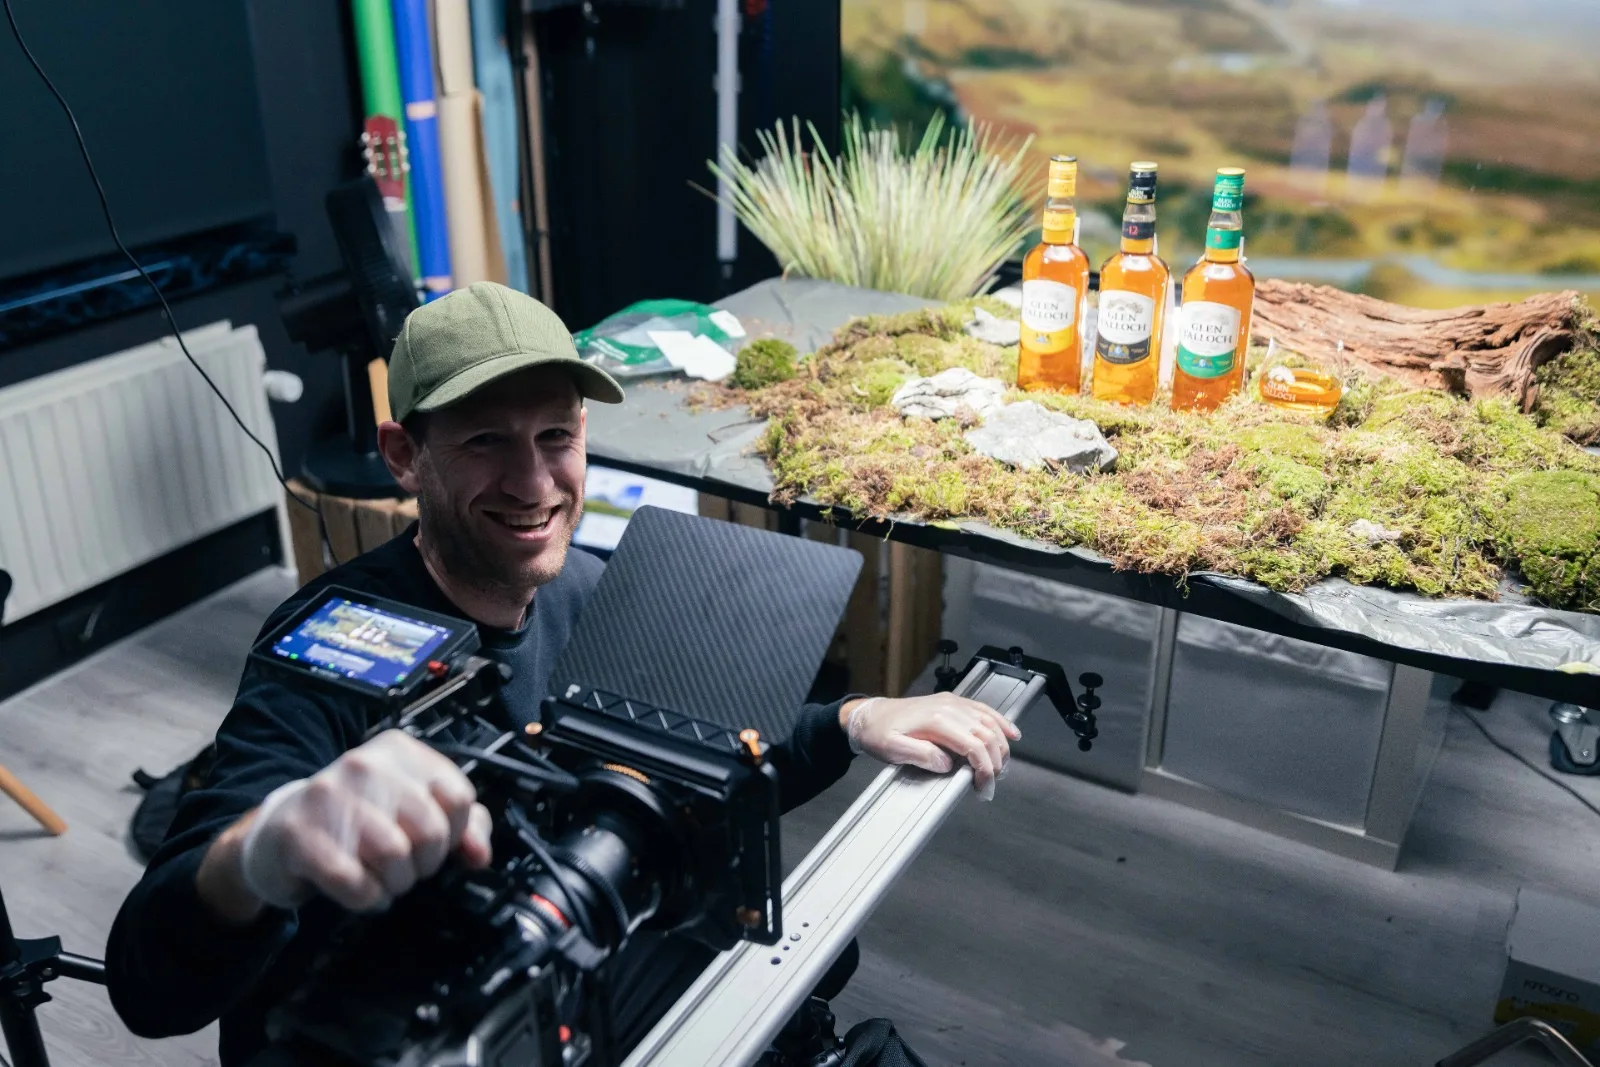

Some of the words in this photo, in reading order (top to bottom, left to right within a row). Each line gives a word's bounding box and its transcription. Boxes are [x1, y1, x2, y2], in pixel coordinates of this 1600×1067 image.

[1128, 225, 1139, 236] 12
[1030, 300, 1059, 311] GLEN
[1024, 307, 1069, 320] ALLOCH
[1107, 311, 1137, 322] GLEN
[1191, 322, 1223, 334] GLEN
[1183, 329, 1233, 344] TALLOCH
